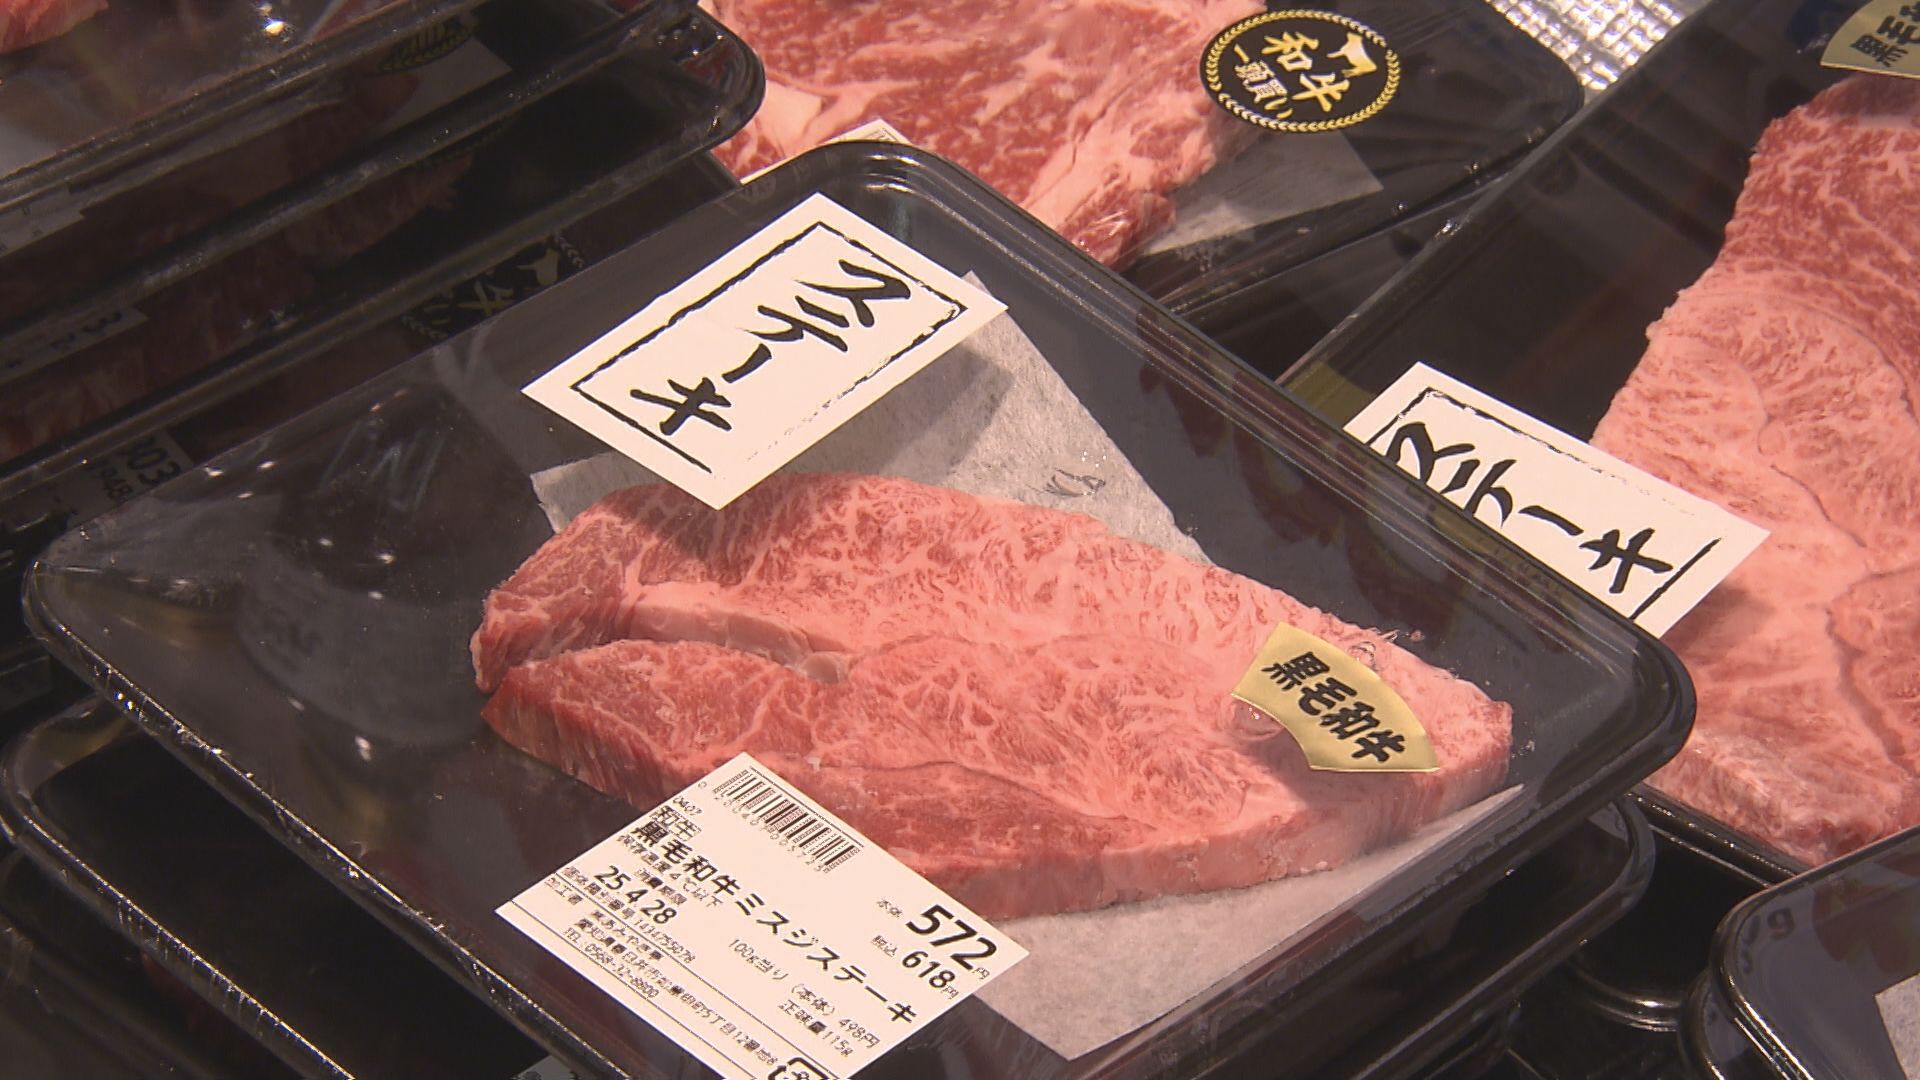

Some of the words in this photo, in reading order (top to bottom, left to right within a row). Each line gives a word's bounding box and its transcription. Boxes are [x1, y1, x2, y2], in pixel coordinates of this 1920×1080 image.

[1234, 44, 1293, 119] 一頭買い
[1262, 32, 1349, 112] 和牛
[630, 259, 912, 436] ステーキ
[1261, 651, 1406, 762] 黒毛和牛
[651, 806, 699, 841] 和牛
[544, 878, 583, 905] 加工者
[634, 868, 687, 905] 消費期限
[877, 901, 902, 917] 本体
[628, 821, 917, 1023] 黒毛和牛ミスジステーキ
[873, 936, 897, 957] 税込
